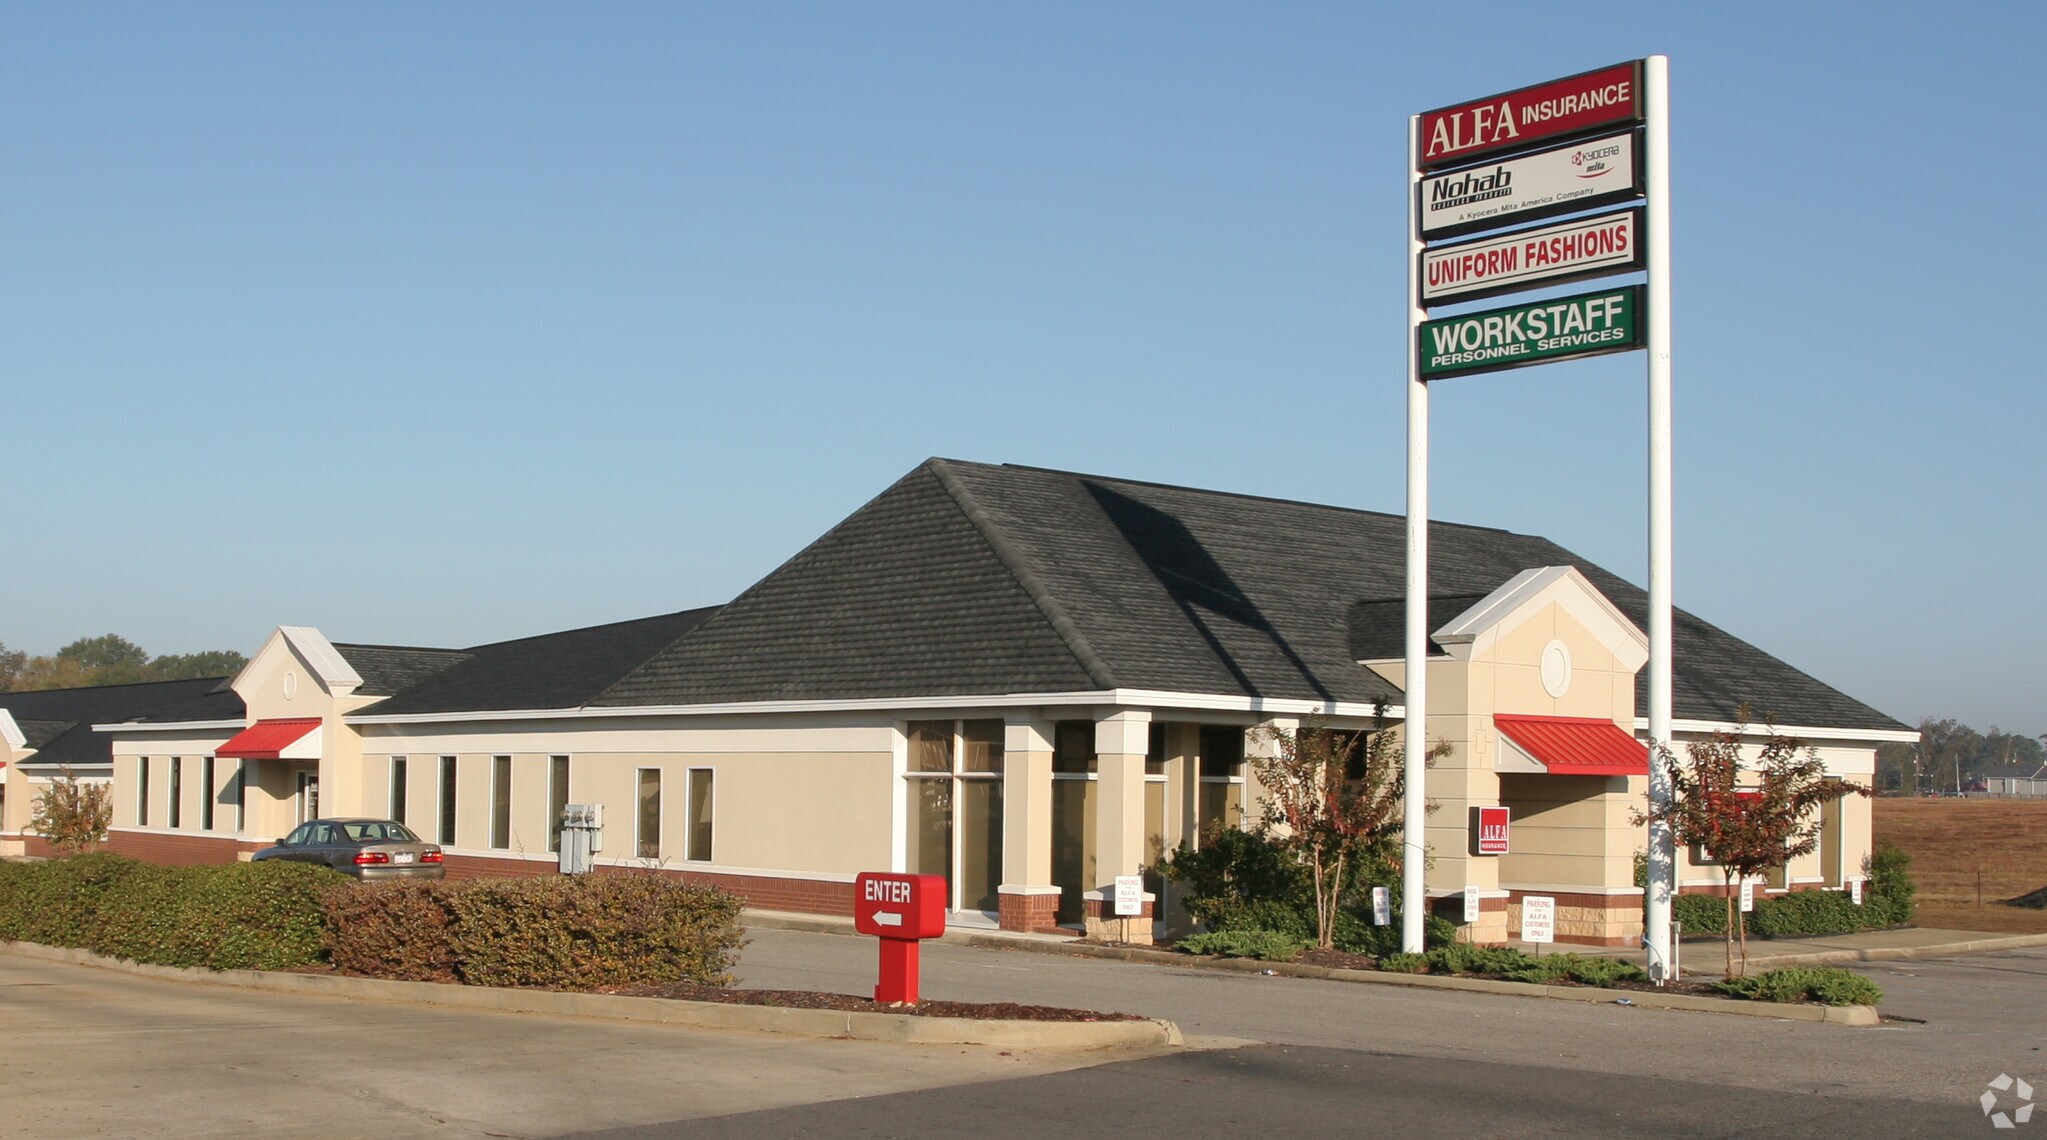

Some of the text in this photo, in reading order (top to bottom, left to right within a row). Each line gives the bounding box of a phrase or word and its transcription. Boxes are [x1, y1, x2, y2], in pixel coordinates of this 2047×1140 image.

[1426, 81, 1630, 157] ALFA INSURANCE
[1582, 145, 1619, 162] KYOCERA
[1586, 162, 1605, 172] mita
[1432, 166, 1512, 202] Nohab
[1467, 208, 1498, 219] Kyocera
[1501, 203, 1518, 212] Mita
[1521, 196, 1553, 208] America
[1556, 187, 1595, 200] Company
[1428, 225, 1627, 286] UNIFORM FASHIONS
[1432, 295, 1624, 355] WORKSTAFF
[1431, 328, 1624, 367] PERSONNEL SERVICES
[1483, 825, 1507, 839] ALFA
[865, 880, 911, 903] ENTER
[1527, 900, 1551, 908] PARKING
